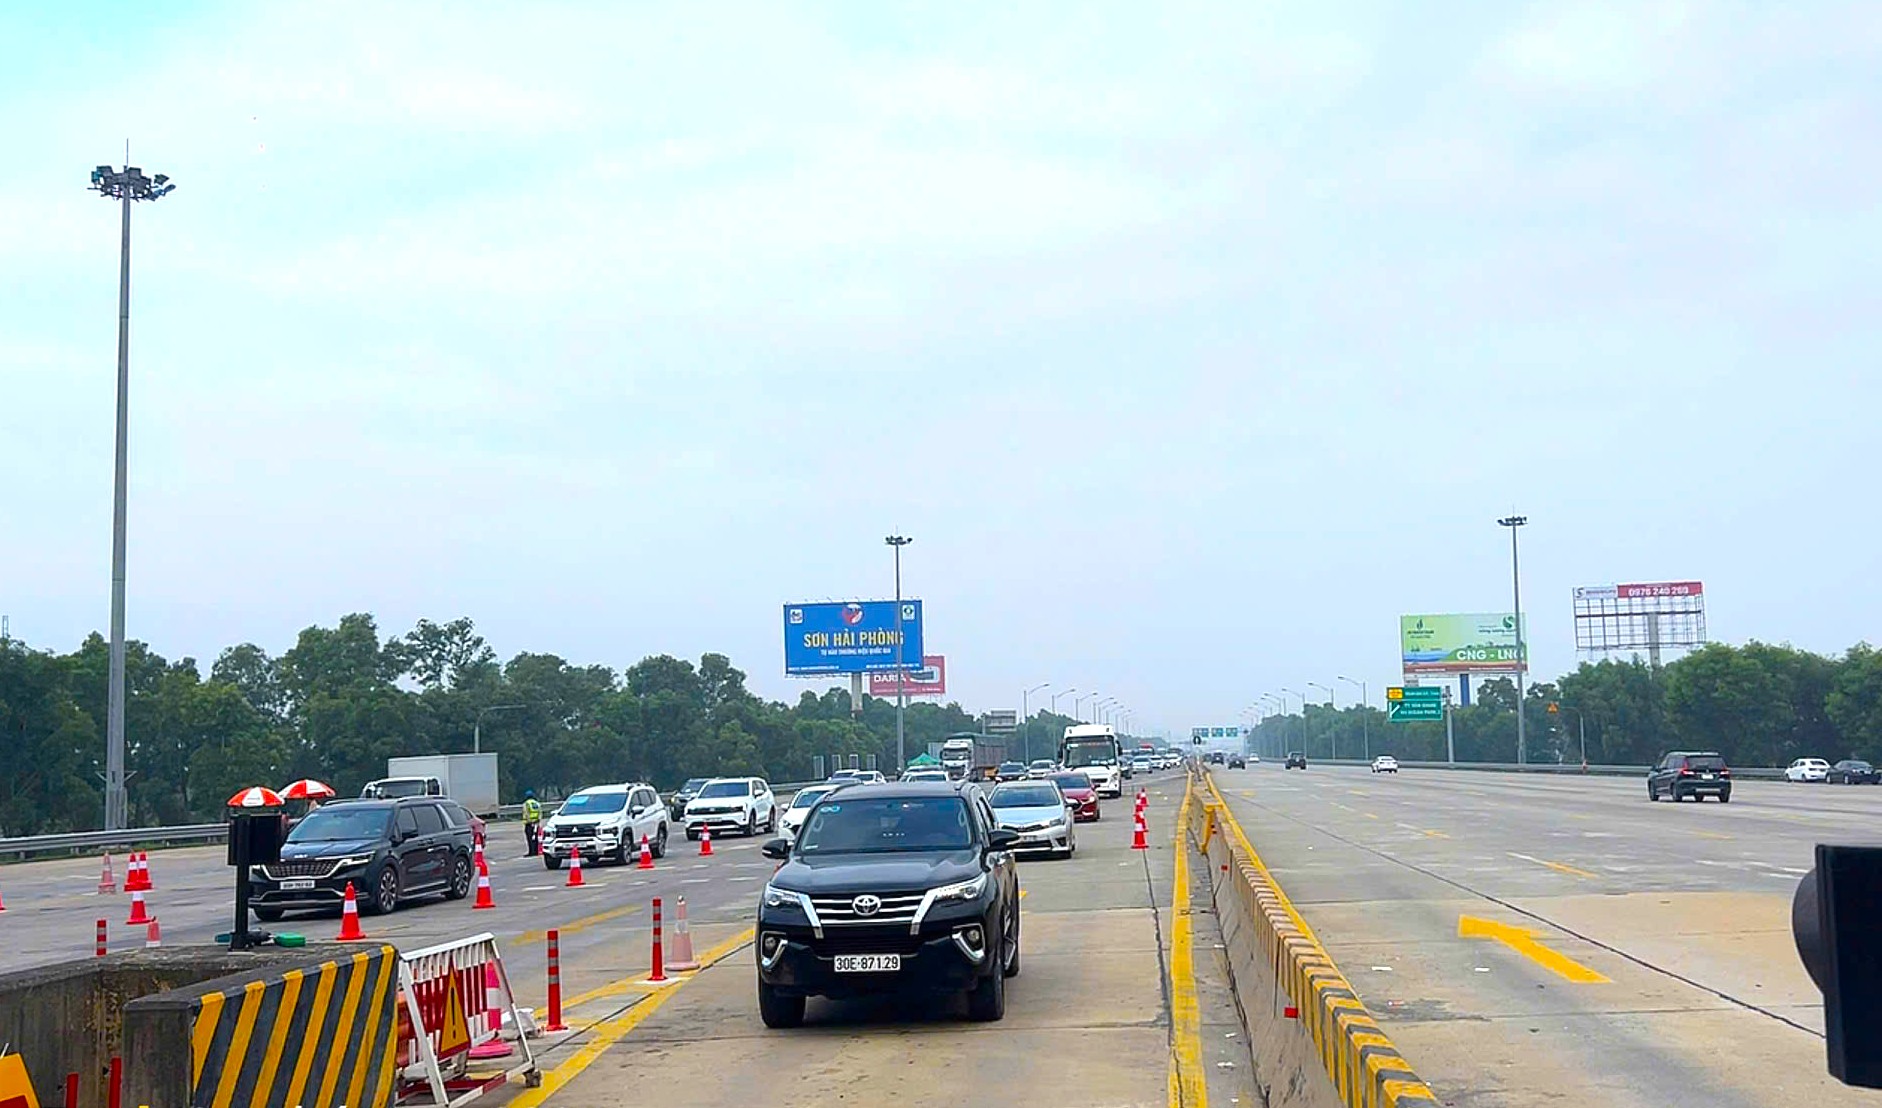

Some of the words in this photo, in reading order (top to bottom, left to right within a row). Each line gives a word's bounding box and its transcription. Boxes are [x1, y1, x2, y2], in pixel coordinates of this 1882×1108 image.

[803, 631, 829, 648] SƠN
[833, 628, 855, 647] HẢI
[860, 626, 904, 646] PHÒNG
[1456, 649, 1487, 660] CNG
